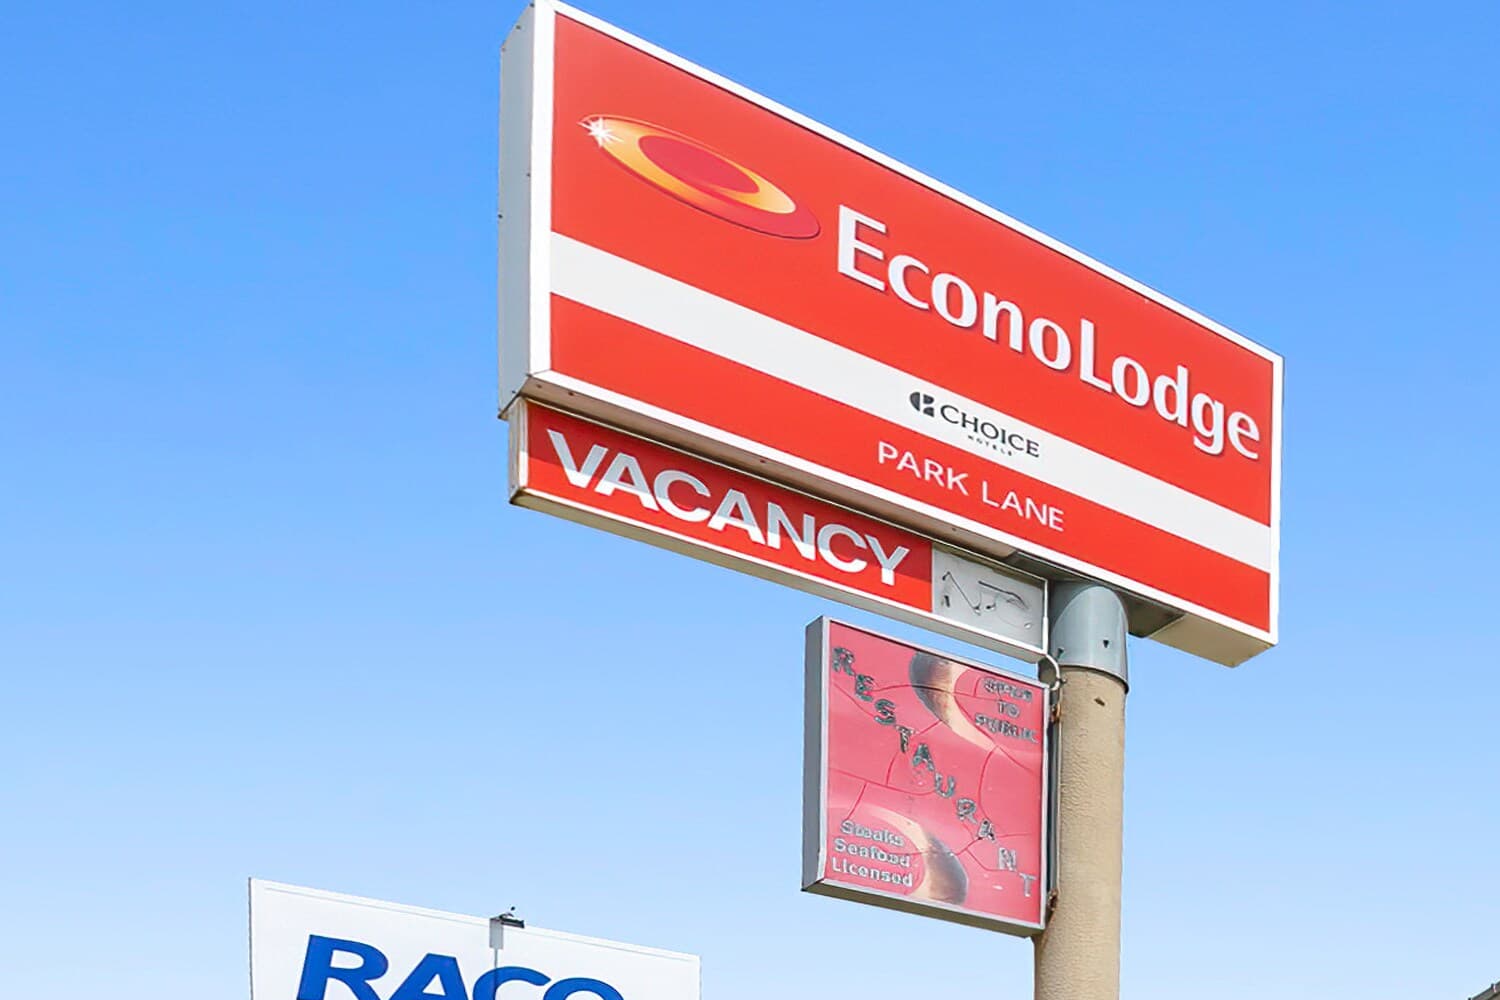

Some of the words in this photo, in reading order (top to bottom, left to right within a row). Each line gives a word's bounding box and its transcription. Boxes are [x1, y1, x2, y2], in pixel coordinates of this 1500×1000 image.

[837, 203, 1260, 459] EconoLodge
[940, 404, 1040, 458] CHOICE
[547, 428, 910, 586] VACANCY
[878, 441, 969, 496] PARK
[981, 480, 1065, 532] LANE
[831, 857, 913, 887] Licensed
[834, 837, 911, 868] Seafood
